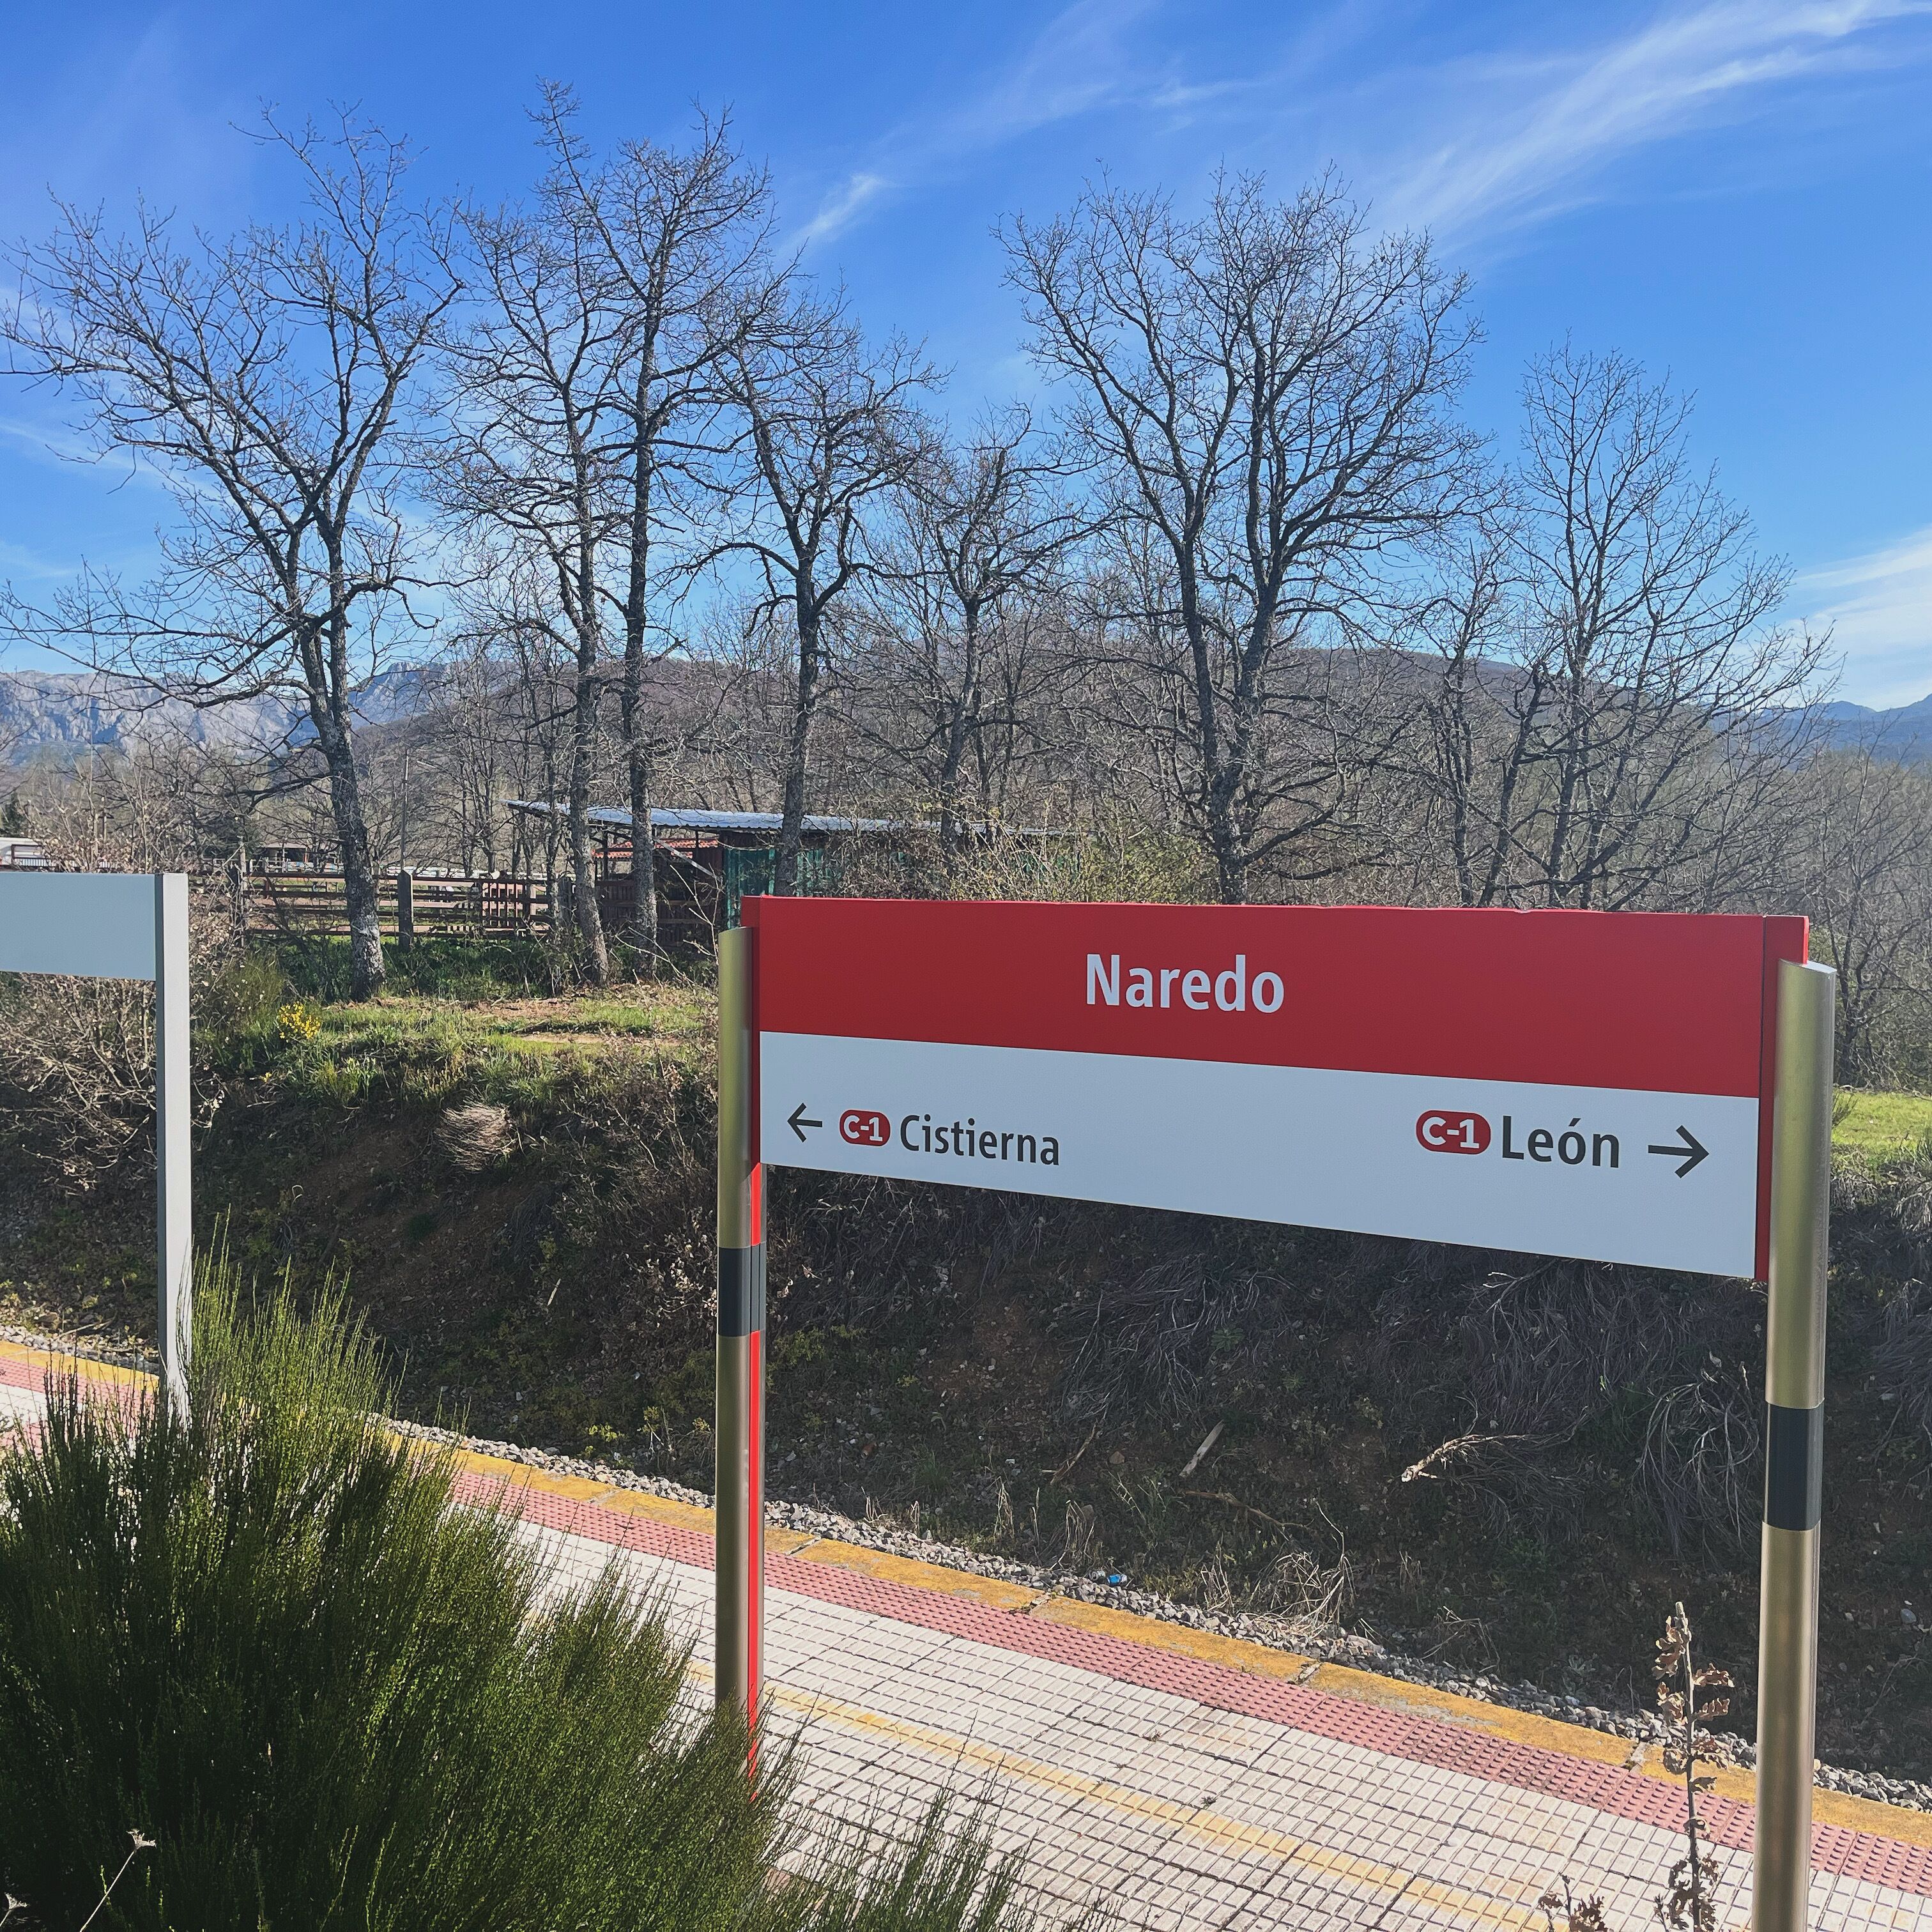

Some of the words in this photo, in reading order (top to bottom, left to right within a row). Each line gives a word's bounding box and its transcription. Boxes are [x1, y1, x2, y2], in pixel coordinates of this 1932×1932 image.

[1086, 953, 1284, 1013] Naredo
[843, 1115, 884, 1142] C-1
[900, 1114, 1059, 1166] Cistierna
[1422, 1116, 1480, 1150] C-1
[1502, 1115, 1620, 1169] León
